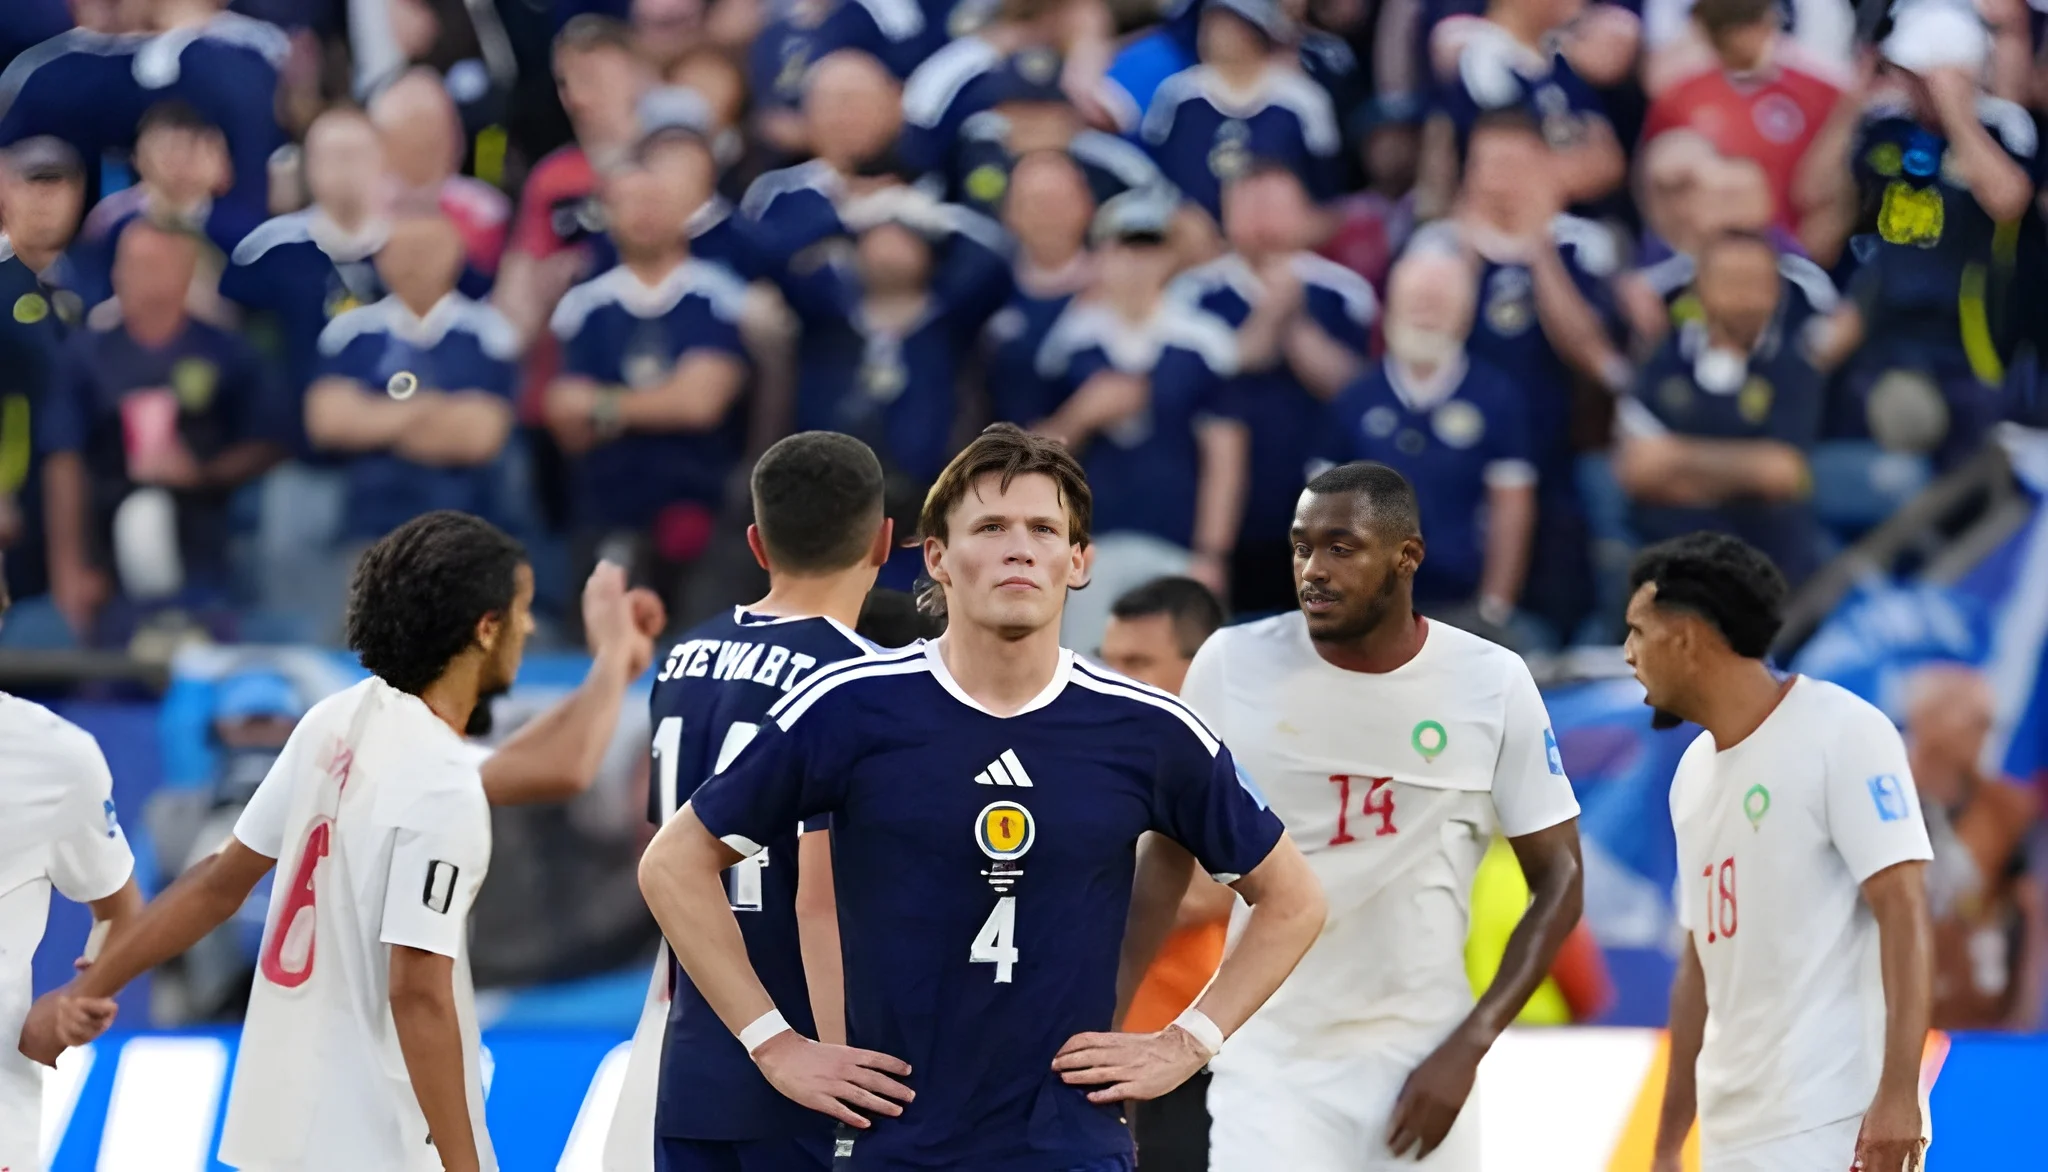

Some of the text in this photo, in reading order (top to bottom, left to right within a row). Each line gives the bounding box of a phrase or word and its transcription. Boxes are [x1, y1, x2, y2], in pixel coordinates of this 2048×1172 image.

[1328, 774, 1398, 846] 14
[260, 821, 330, 988] 6
[968, 896, 1019, 983] 4
[1702, 856, 1738, 944] 18
